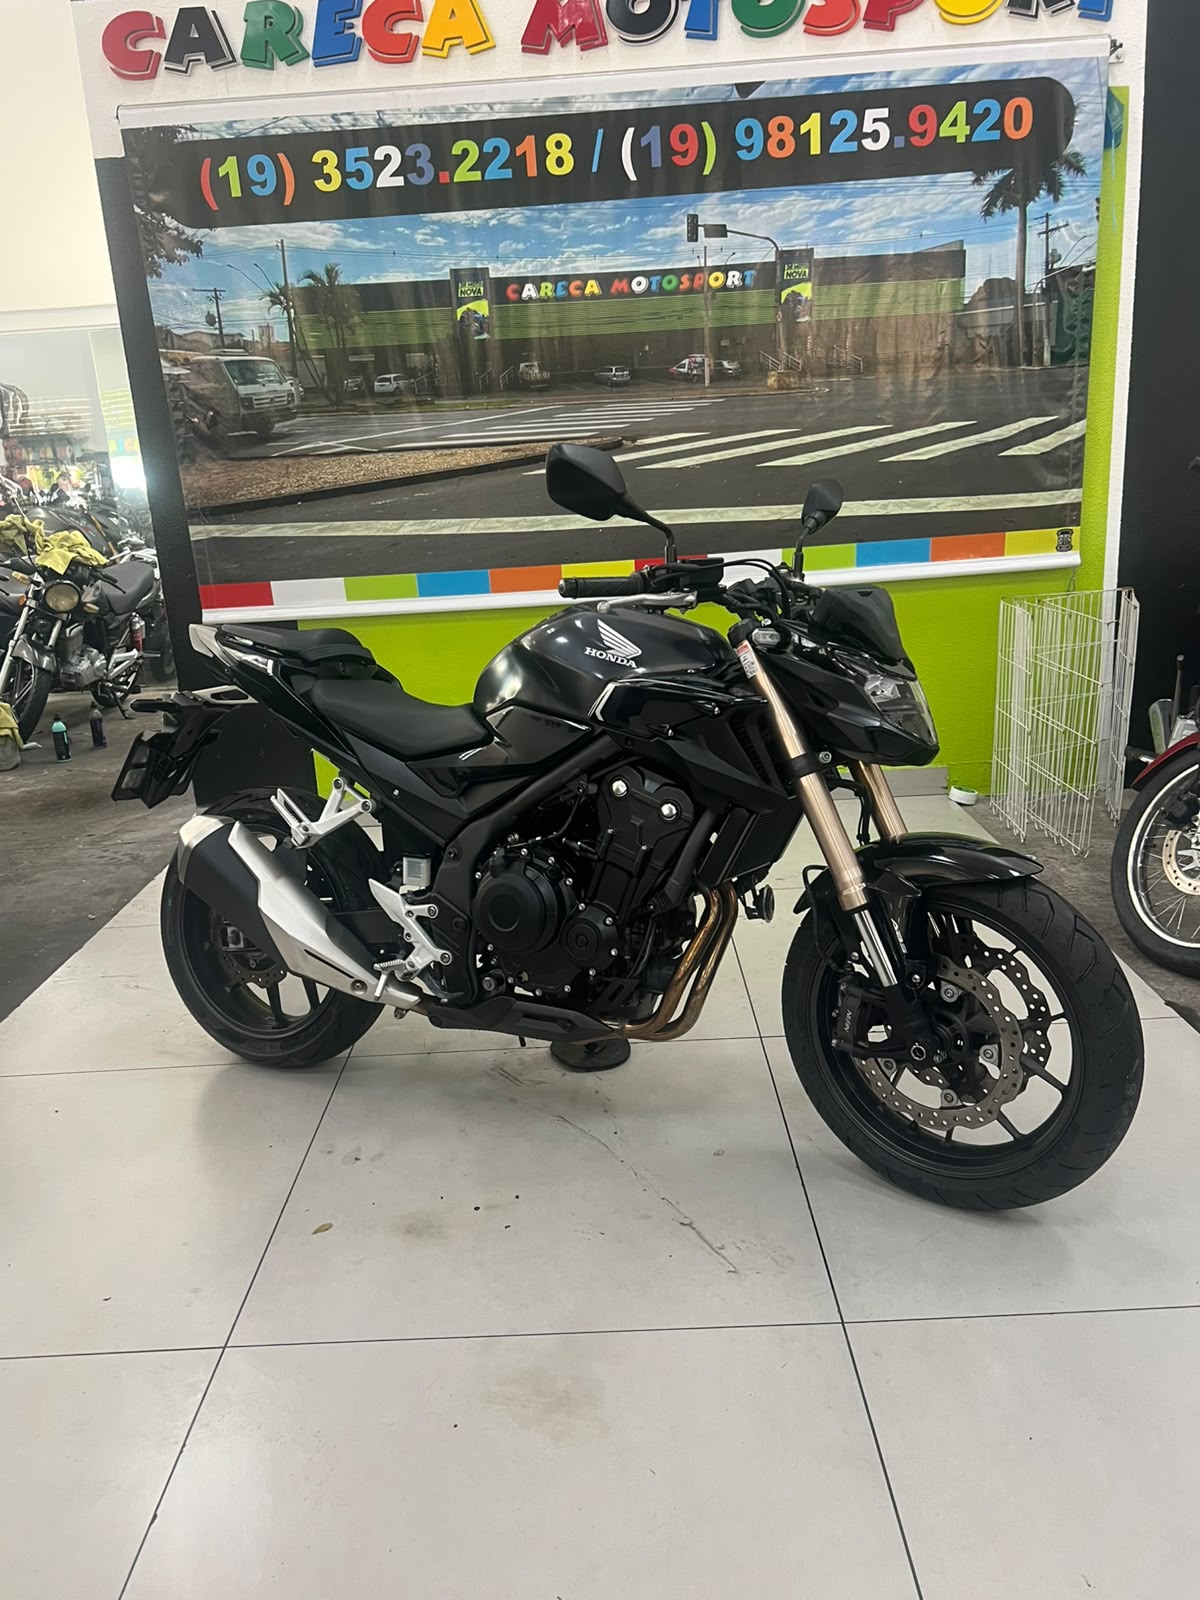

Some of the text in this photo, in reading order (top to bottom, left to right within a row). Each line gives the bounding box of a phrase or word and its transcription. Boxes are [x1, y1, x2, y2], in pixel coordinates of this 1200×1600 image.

[101, 0, 496, 80] CARECA
[199, 97, 1034, 211] (19) 3523.2218 / (19) 98125.9420
[506, 270, 757, 301] CARECA MOTOSPORT
[784, 270, 808, 279] NOVA
[458, 287, 483, 297] NOVA
[584, 646, 638, 669] HONDA
